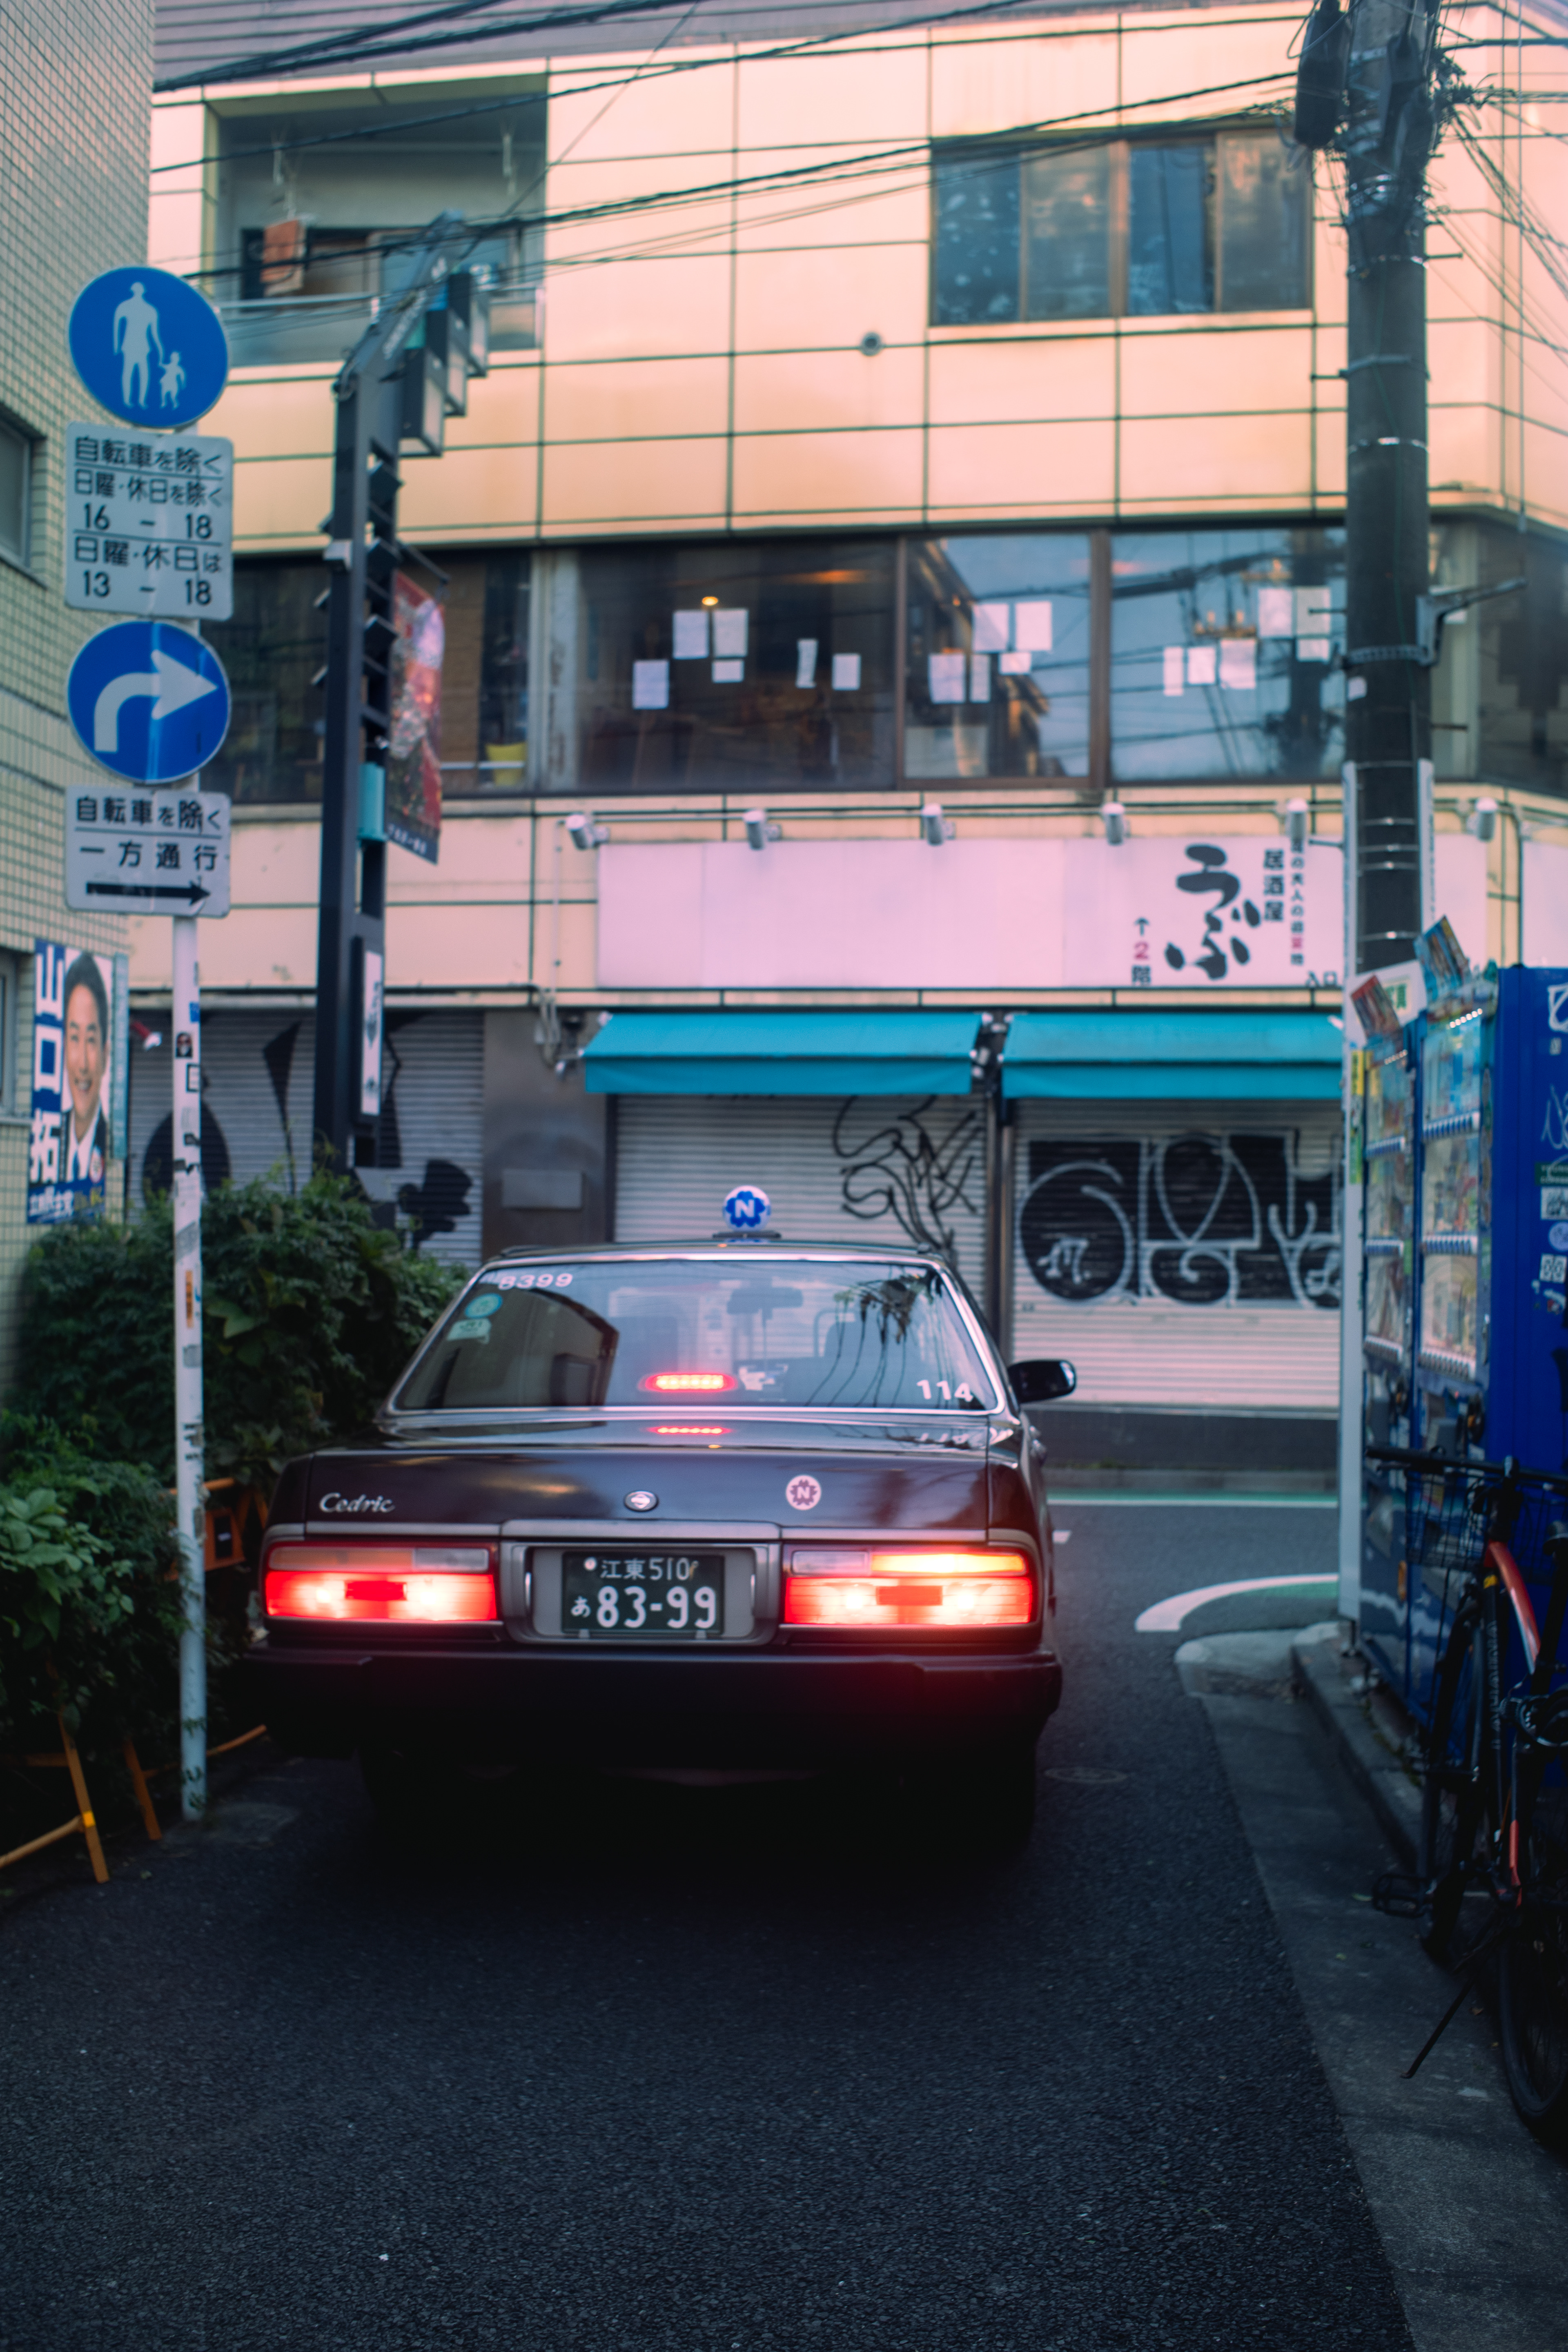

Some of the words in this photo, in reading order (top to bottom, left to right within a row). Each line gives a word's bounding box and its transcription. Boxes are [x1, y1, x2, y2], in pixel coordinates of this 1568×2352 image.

[76, 436, 222, 474] 自転車を除く
[84, 503, 110, 531] 16
[185, 513, 212, 539] 18
[84, 570, 110, 597] 13
[185, 578, 212, 606] 18
[76, 796, 221, 833] 自転車を除く
[80, 841, 218, 871] 一方通行
[1263, 849, 1284, 923] 居酒屋
[735, 1199, 755, 1218] N
[498, 1272, 573, 1291] 8399
[916, 1379, 973, 1402] 114
[319, 1492, 396, 1513] Cedric
[797, 1486, 810, 1499] N
[597, 1585, 717, 1629] 83-99
